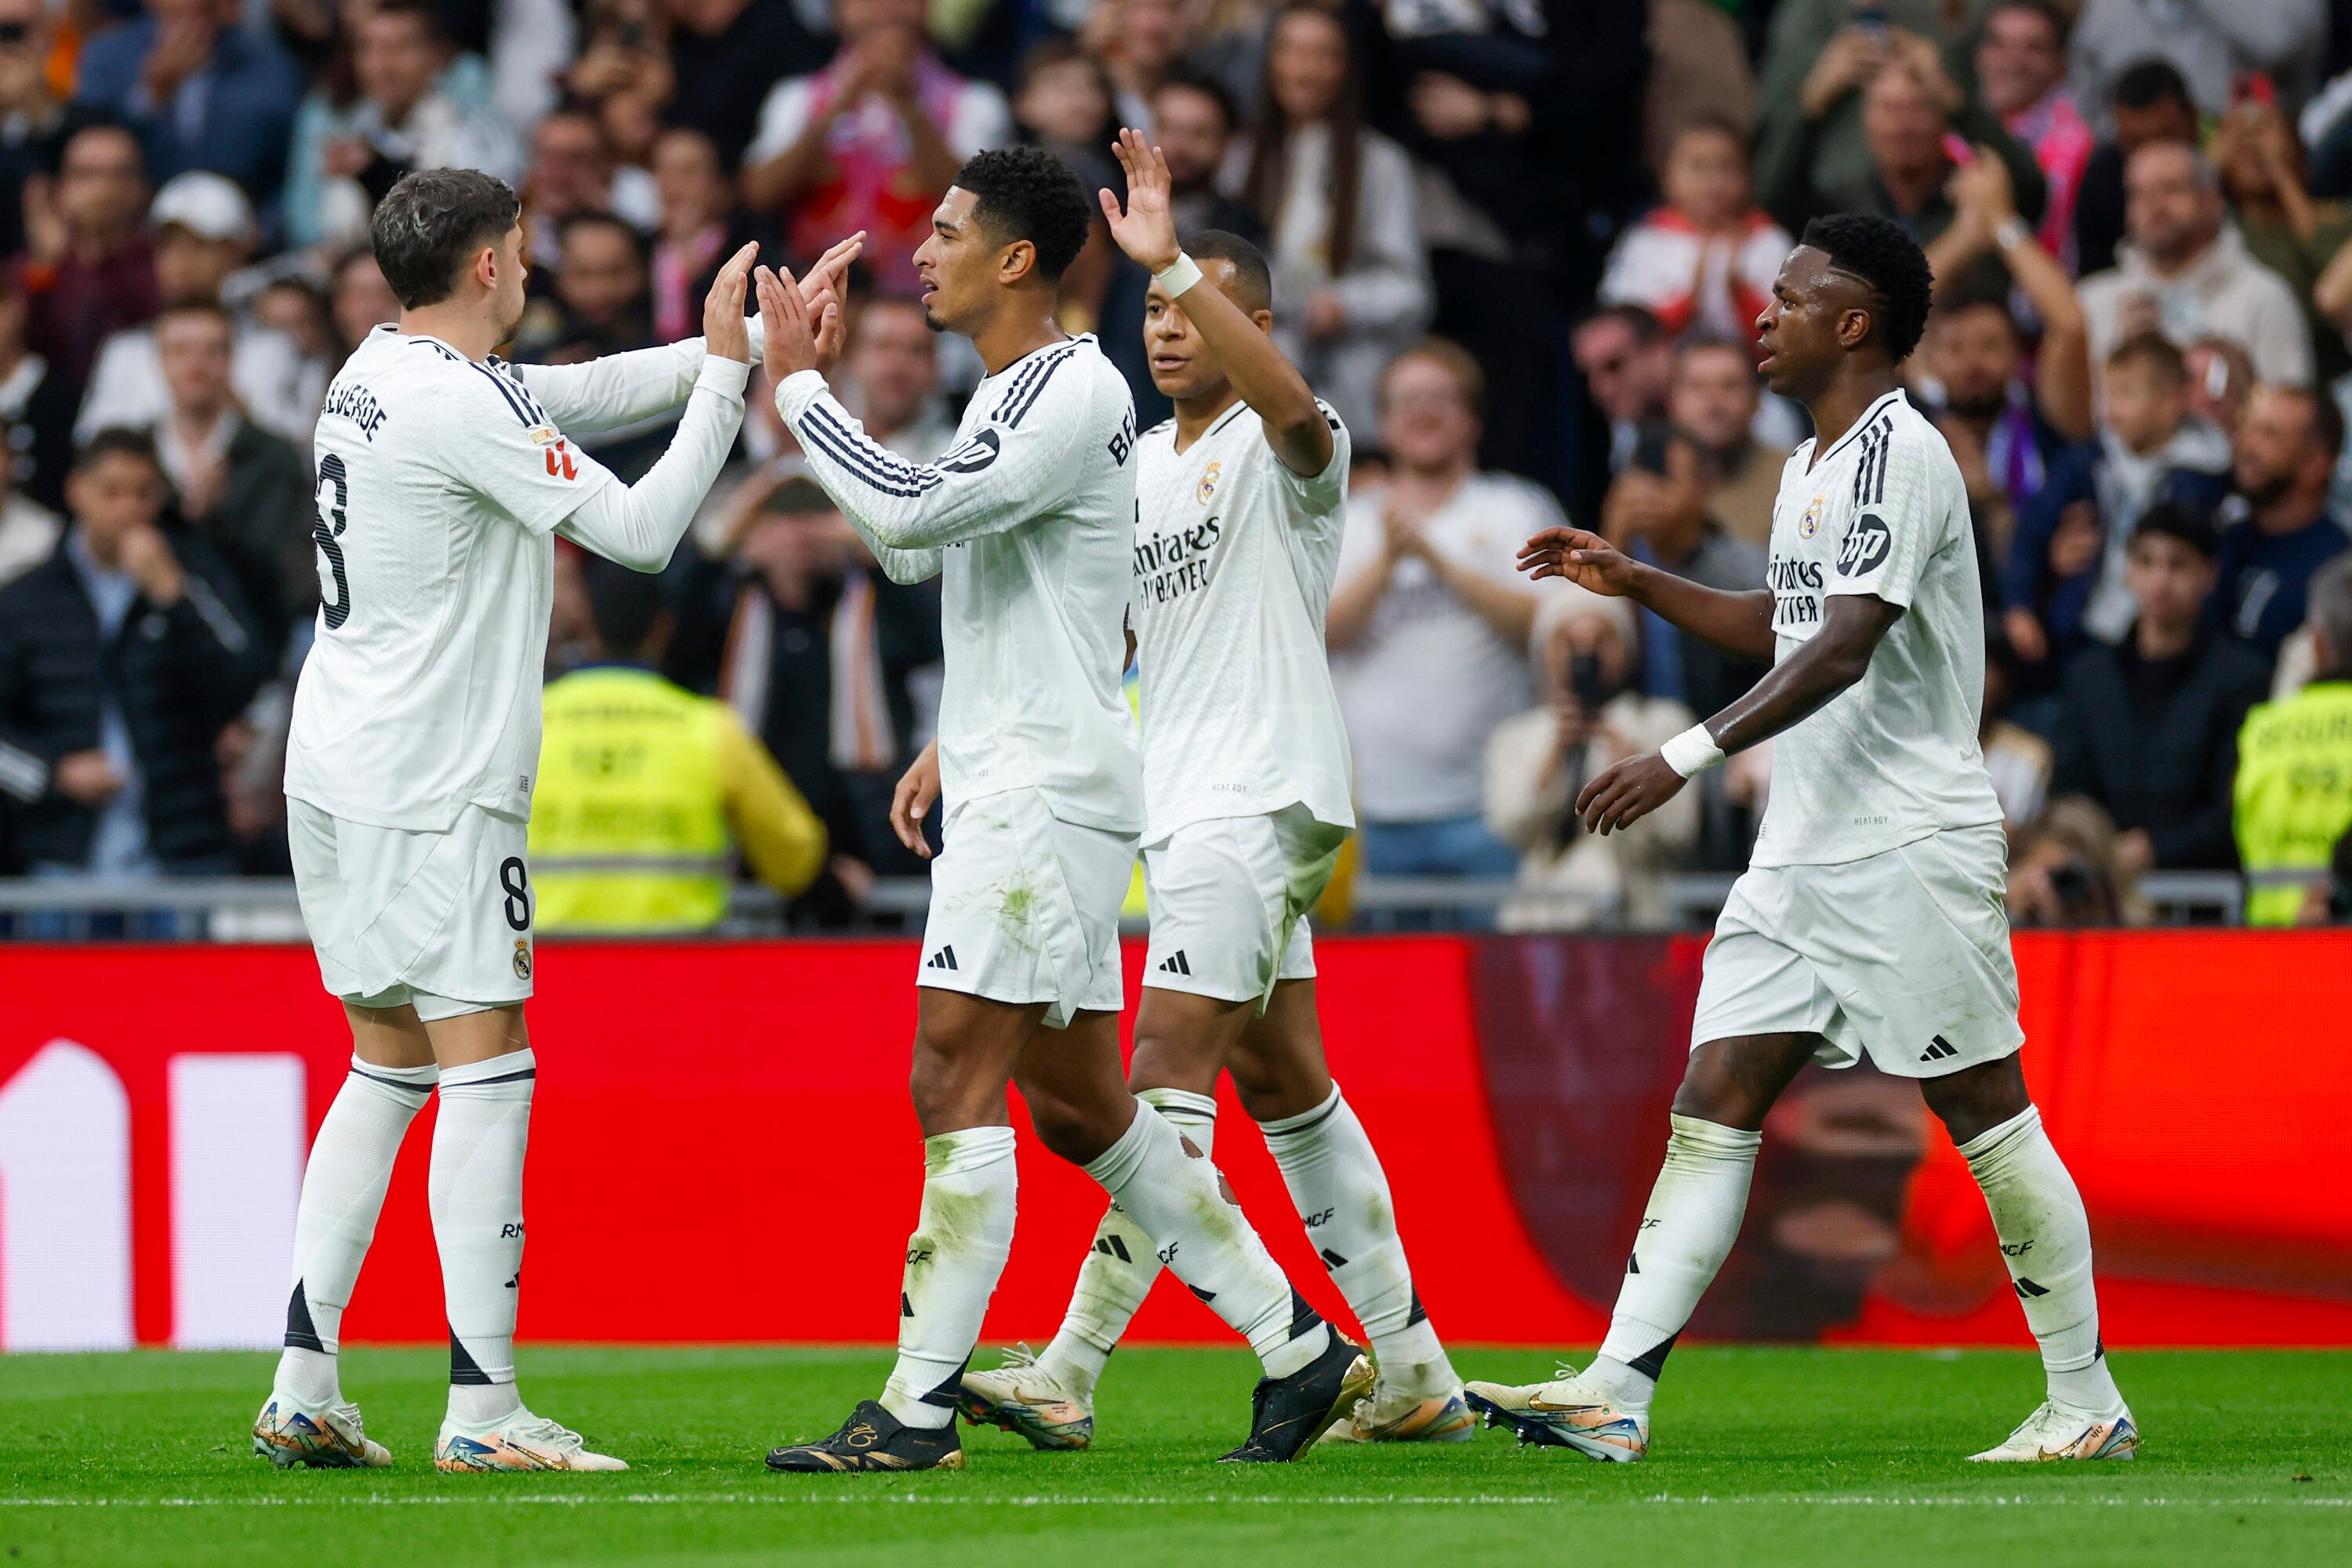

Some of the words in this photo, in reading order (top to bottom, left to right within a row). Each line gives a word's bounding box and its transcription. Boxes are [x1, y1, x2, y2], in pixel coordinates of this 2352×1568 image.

[315, 453, 350, 630] 8
[1134, 516, 1220, 577] mirates
[1838, 513, 1890, 578] hp
[1770, 553, 1824, 590] irates
[1776, 595, 1818, 625] TTER
[500, 856, 530, 931] 8
[906, 1249, 932, 1265] CF
[1156, 1241, 1178, 1265] CF
